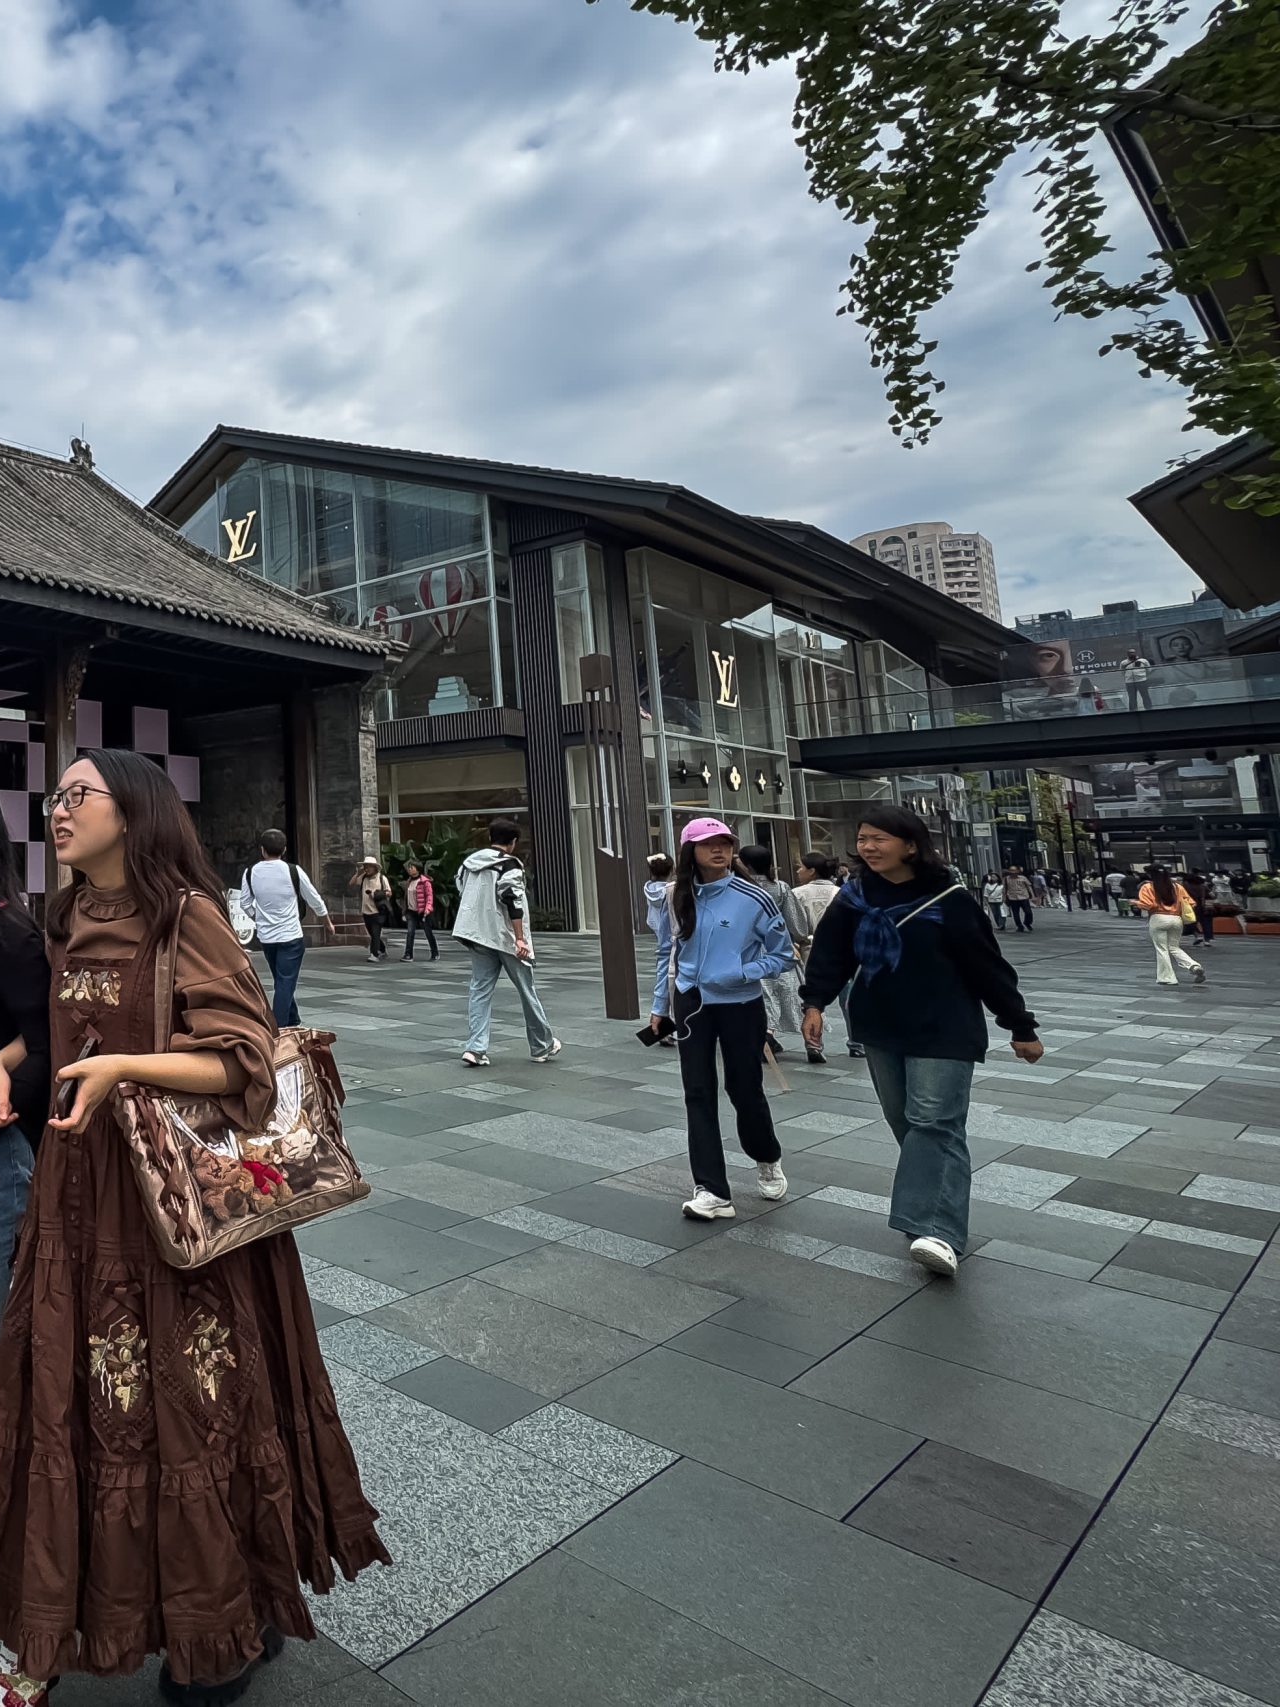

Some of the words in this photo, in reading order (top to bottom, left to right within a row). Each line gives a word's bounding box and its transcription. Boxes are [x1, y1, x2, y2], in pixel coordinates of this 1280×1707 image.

[221, 510, 257, 563] LV
[712, 650, 738, 707] LV
[1088, 661, 1117, 670] HOUSE
